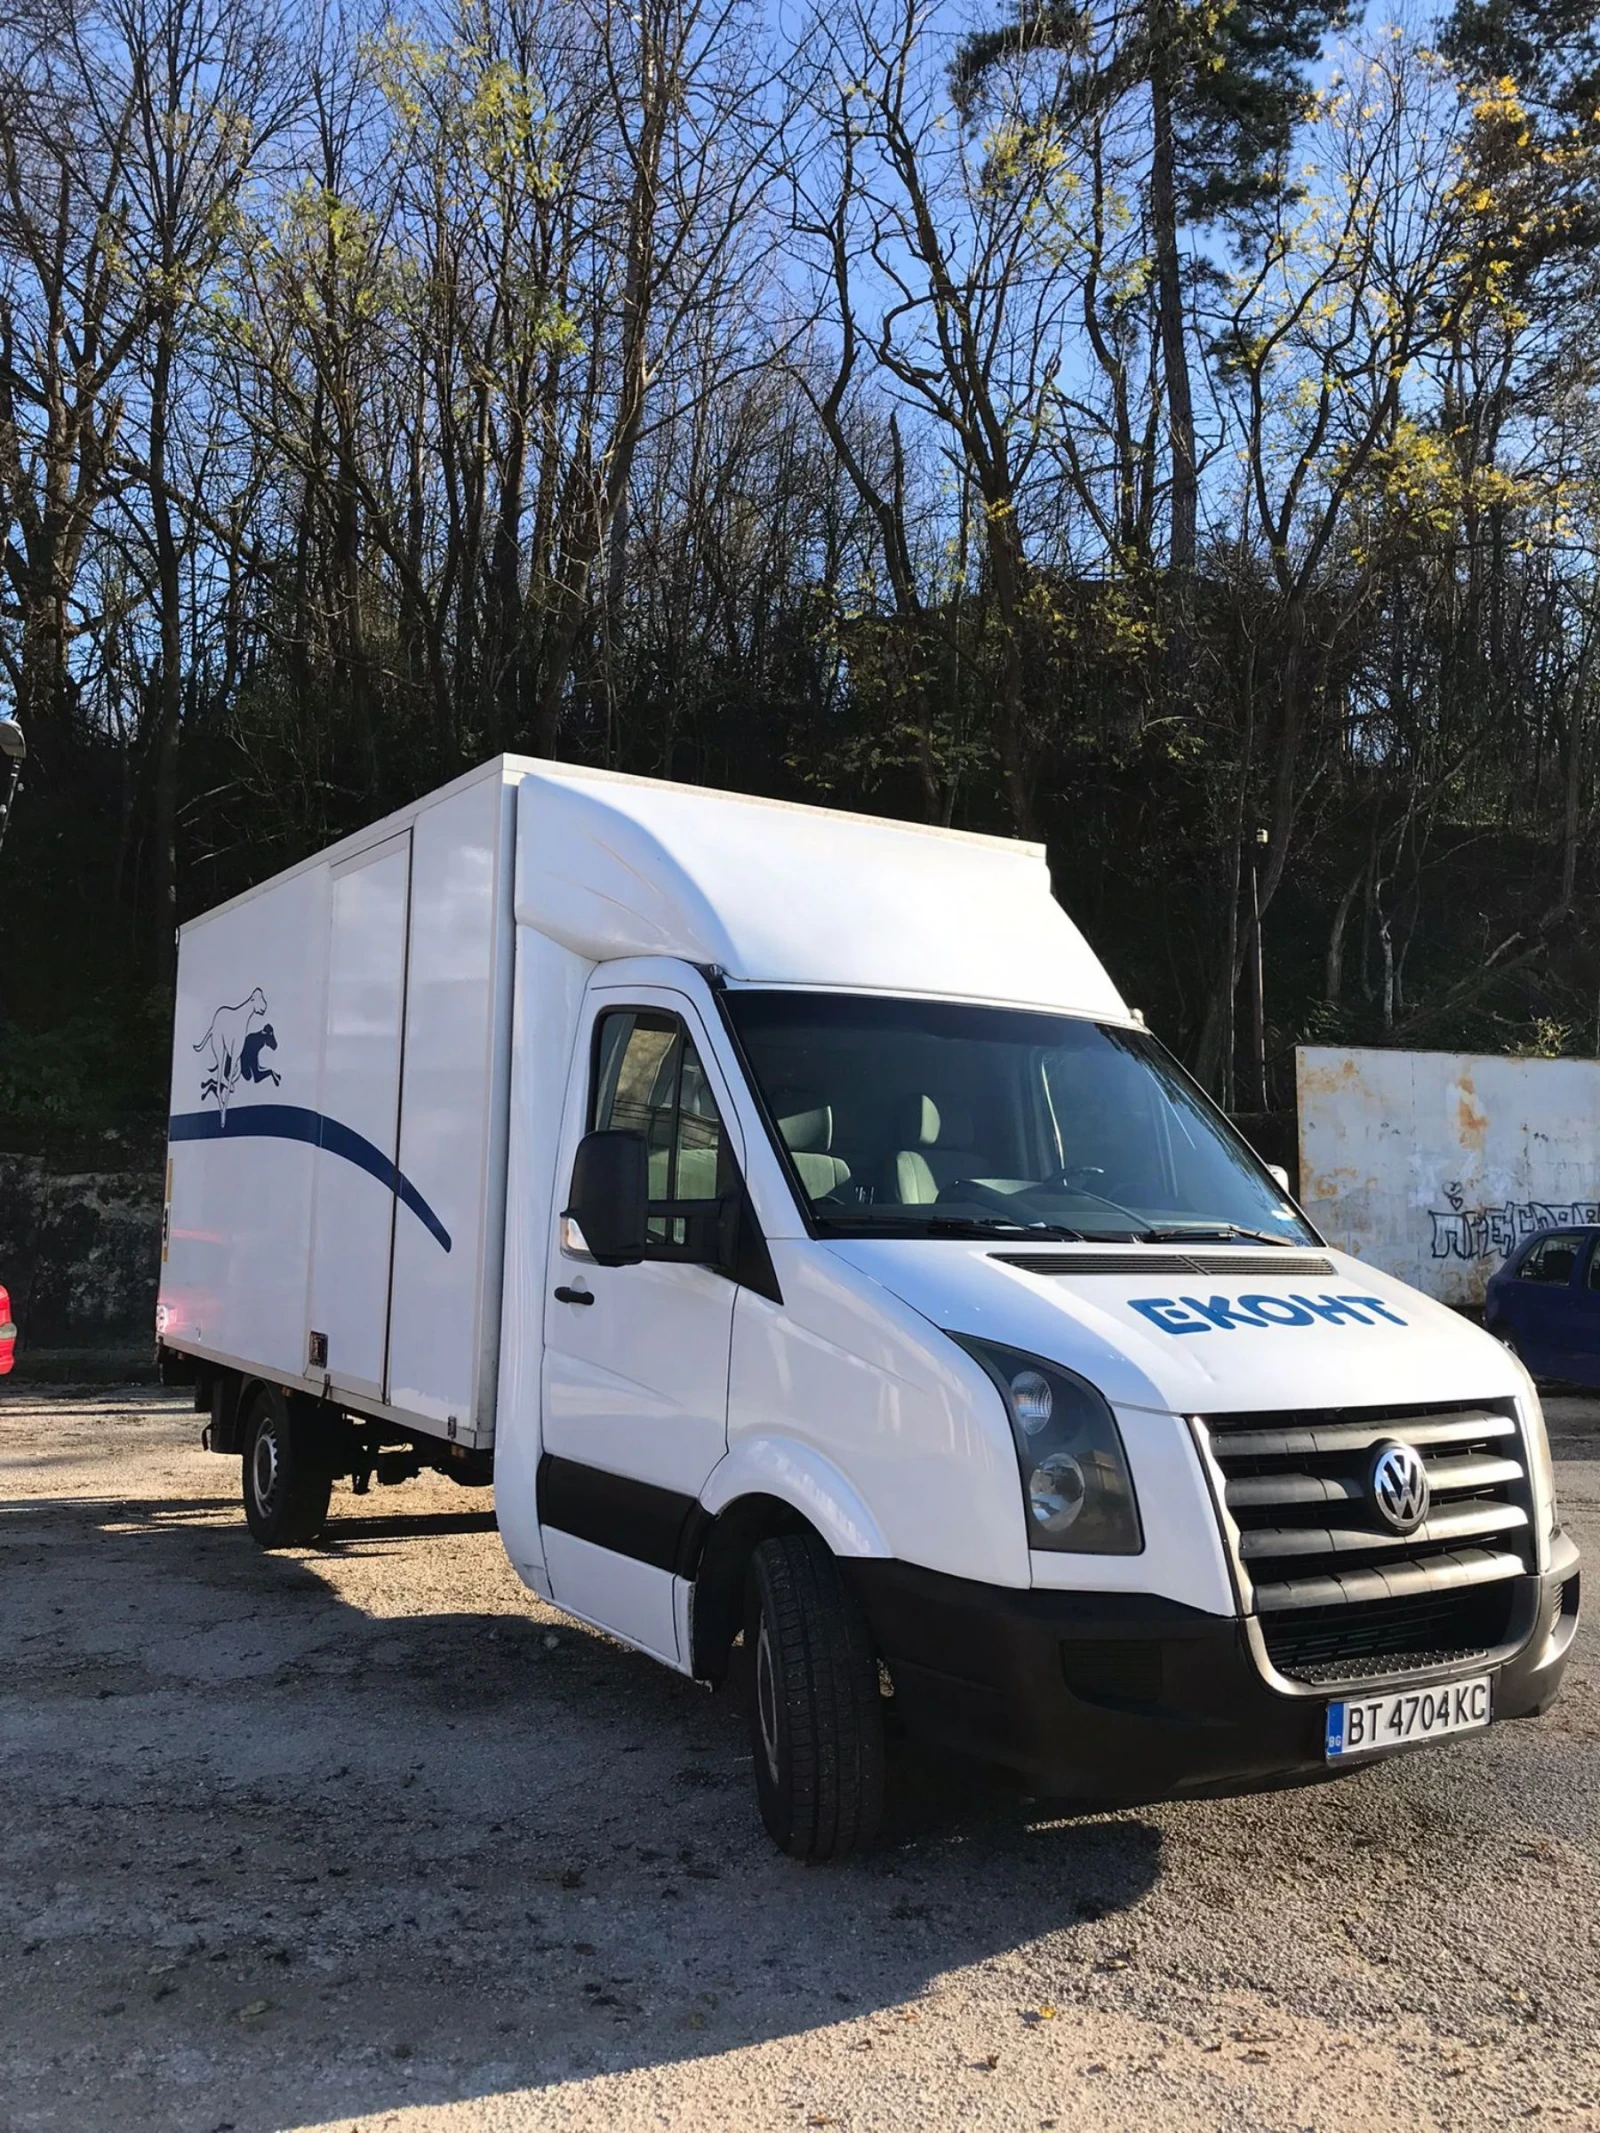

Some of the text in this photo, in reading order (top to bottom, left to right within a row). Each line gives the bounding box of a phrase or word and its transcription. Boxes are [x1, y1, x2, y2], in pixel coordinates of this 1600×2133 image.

[1127, 1294, 1409, 1335] ЕКОНТ
[1347, 1683, 1486, 1746] BT 4704 KC
[1328, 1734, 1342, 1748] BG
